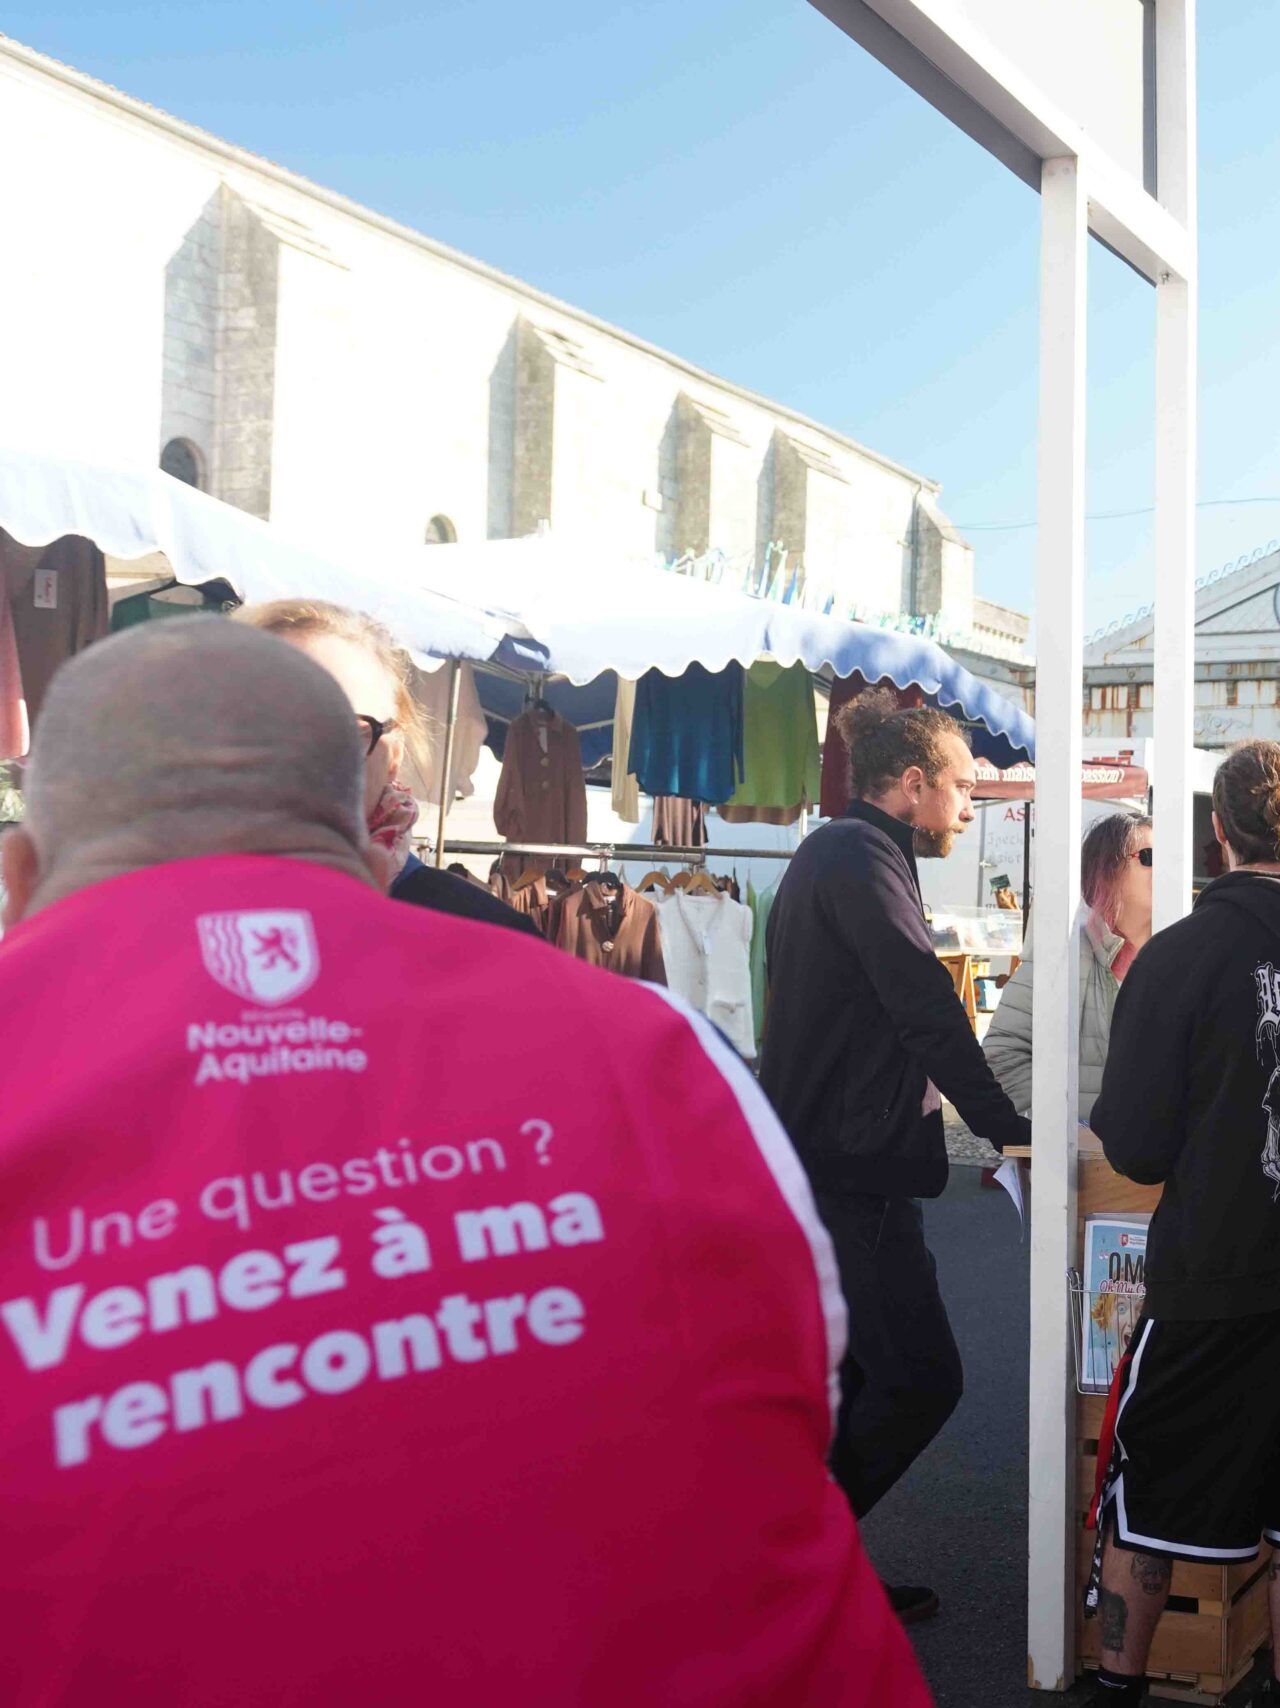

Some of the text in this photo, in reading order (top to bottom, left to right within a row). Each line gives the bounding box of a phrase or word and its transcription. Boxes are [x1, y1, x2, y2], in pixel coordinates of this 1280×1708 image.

[187, 1016, 362, 1051] Nouvelle-
[195, 1043, 367, 1085] Aquitaine
[33, 1118, 553, 1271] Une question ?
[0, 1191, 604, 1372] Venez à ma
[53, 1286, 584, 1467] rencontre
